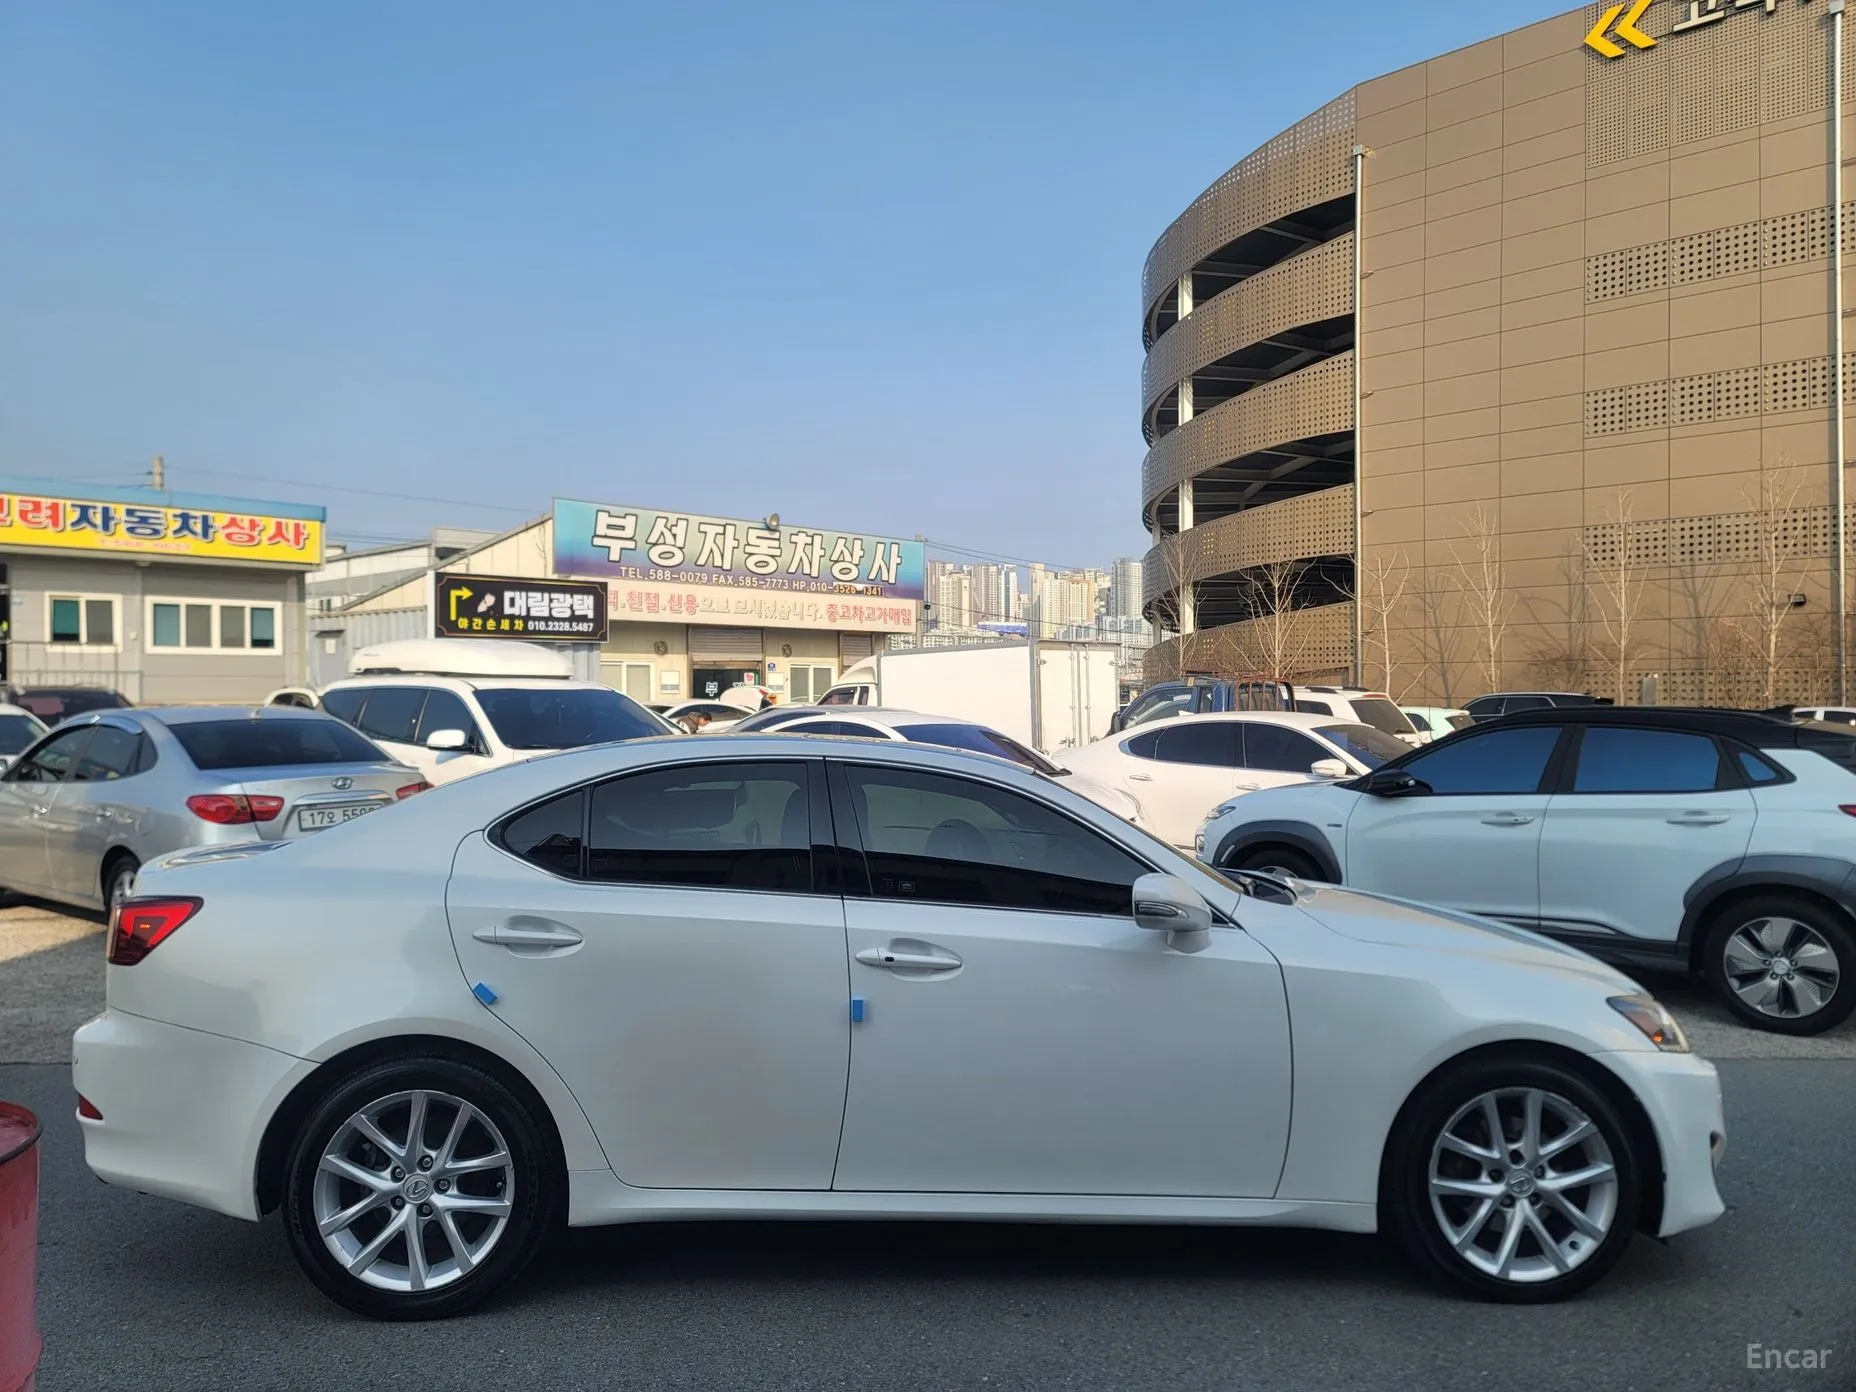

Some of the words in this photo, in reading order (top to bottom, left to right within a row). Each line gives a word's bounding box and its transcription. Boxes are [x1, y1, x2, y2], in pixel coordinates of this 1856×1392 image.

[620, 566, 708, 584] TEL.588-0079
[712, 573, 789, 590] FAX.585-7773
[503, 590, 595, 619] 대림광택
[527, 620, 594, 632] 010.2328.5487
